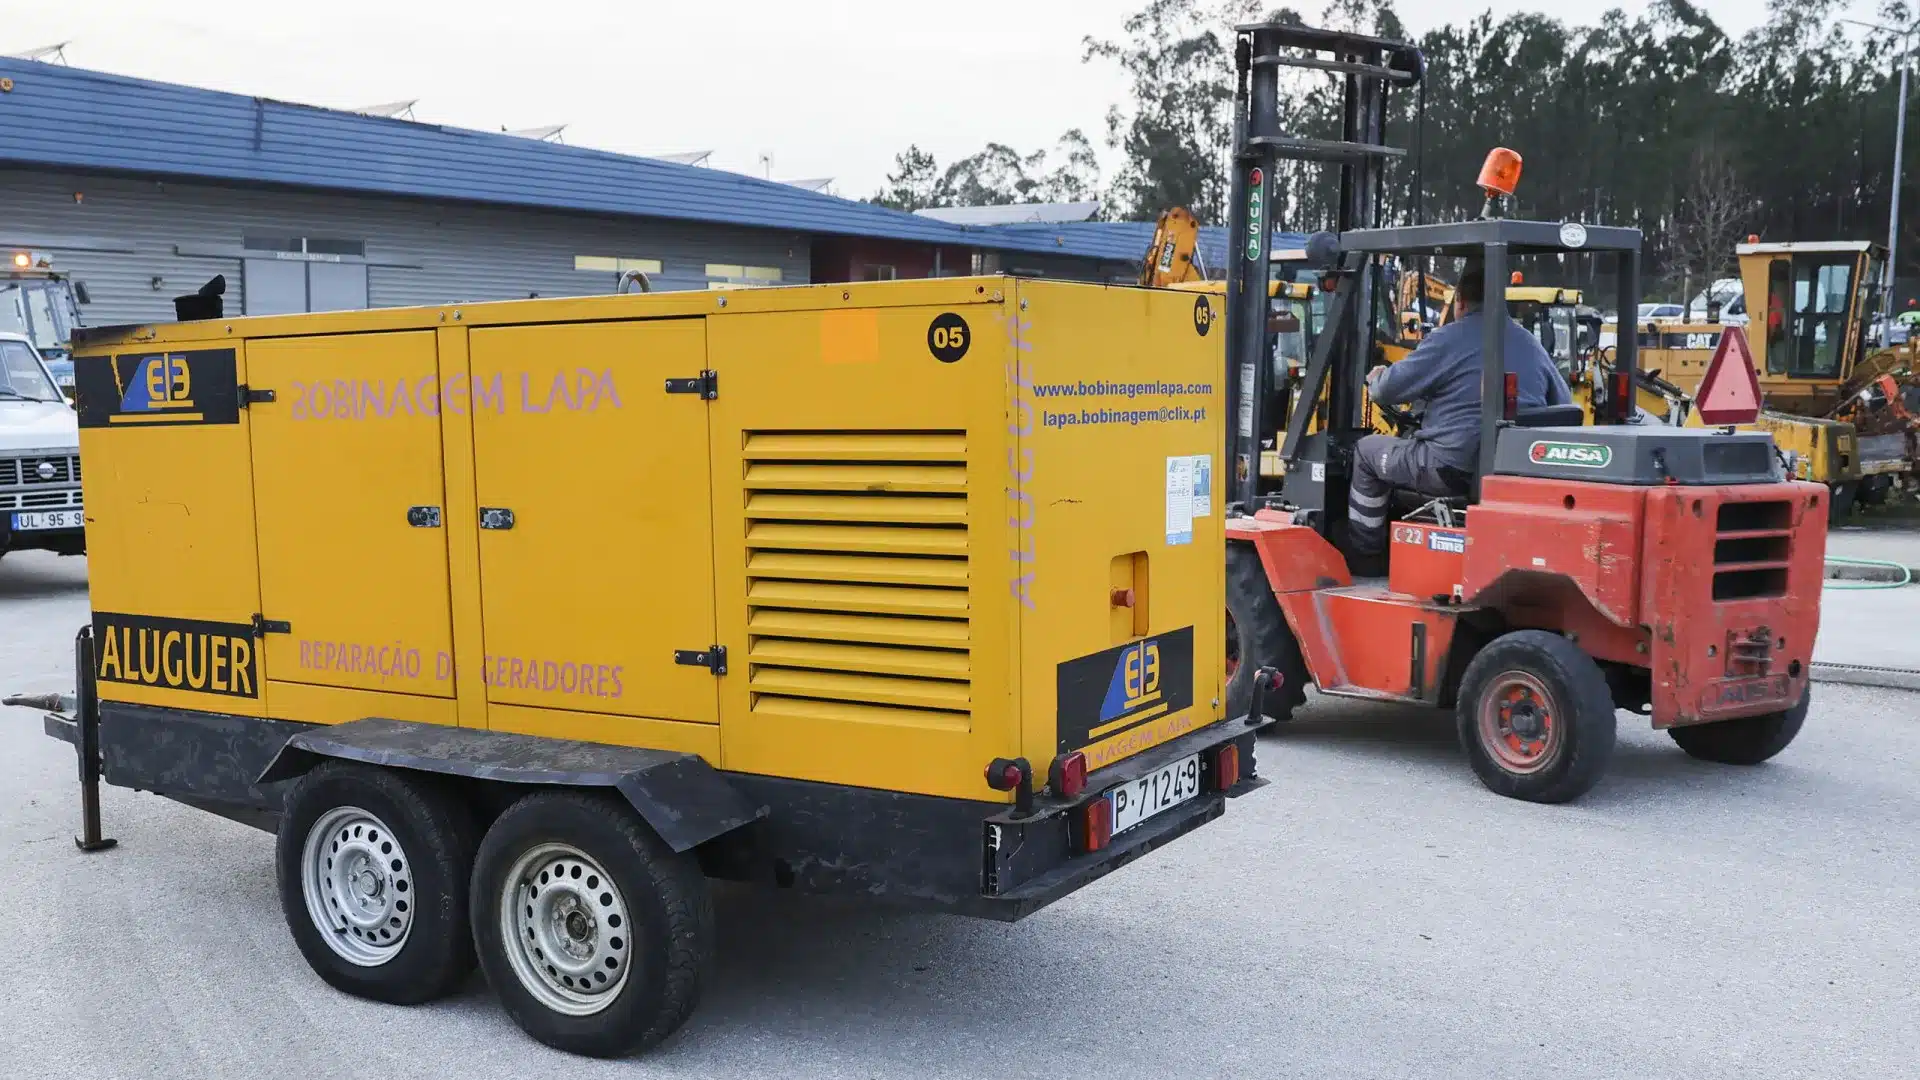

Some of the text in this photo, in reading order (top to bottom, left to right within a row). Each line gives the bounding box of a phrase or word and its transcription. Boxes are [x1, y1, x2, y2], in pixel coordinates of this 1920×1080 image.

[1248, 192, 1260, 250] AUSA
[1195, 305, 1209, 325] 05
[933, 326, 964, 349] 05
[1686, 333, 1713, 349] CAT
[291, 367, 623, 421] BOBINAGEM LAPA
[1032, 380, 1213, 399] www.bobinagemlapa.com
[1043, 406, 1206, 429] lapa.bobinagem@clix.pt
[1546, 447, 1604, 462] AUSA
[20, 514, 39, 528] UL
[48, 513, 65, 526] 95
[100, 625, 252, 694] ALUGUER
[299, 639, 421, 684] REPARAÇÃO
[480, 653, 625, 699] GERADORES
